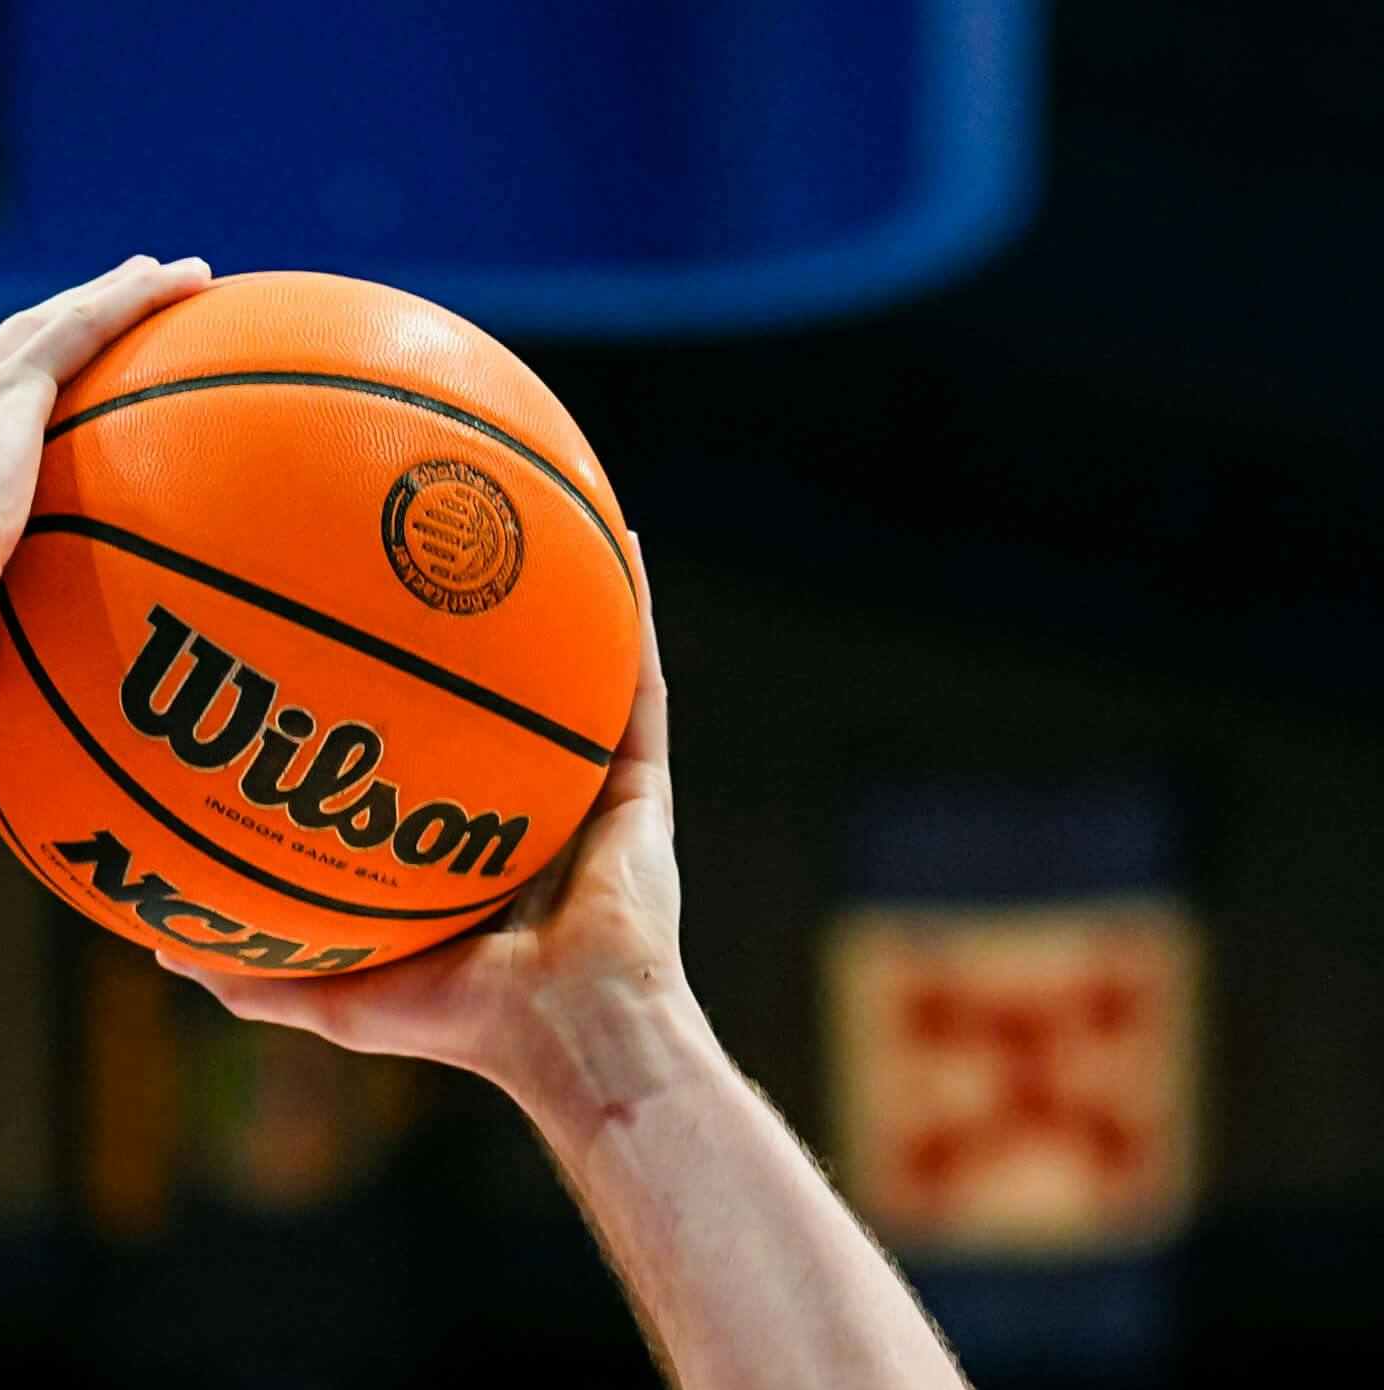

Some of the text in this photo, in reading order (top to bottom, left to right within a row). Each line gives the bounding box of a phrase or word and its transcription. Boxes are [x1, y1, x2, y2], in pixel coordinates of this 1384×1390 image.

[119, 603, 530, 878] Wilson
[51, 829, 378, 971] NCAA
[205, 795, 399, 889] INDOOR GAME BALL
